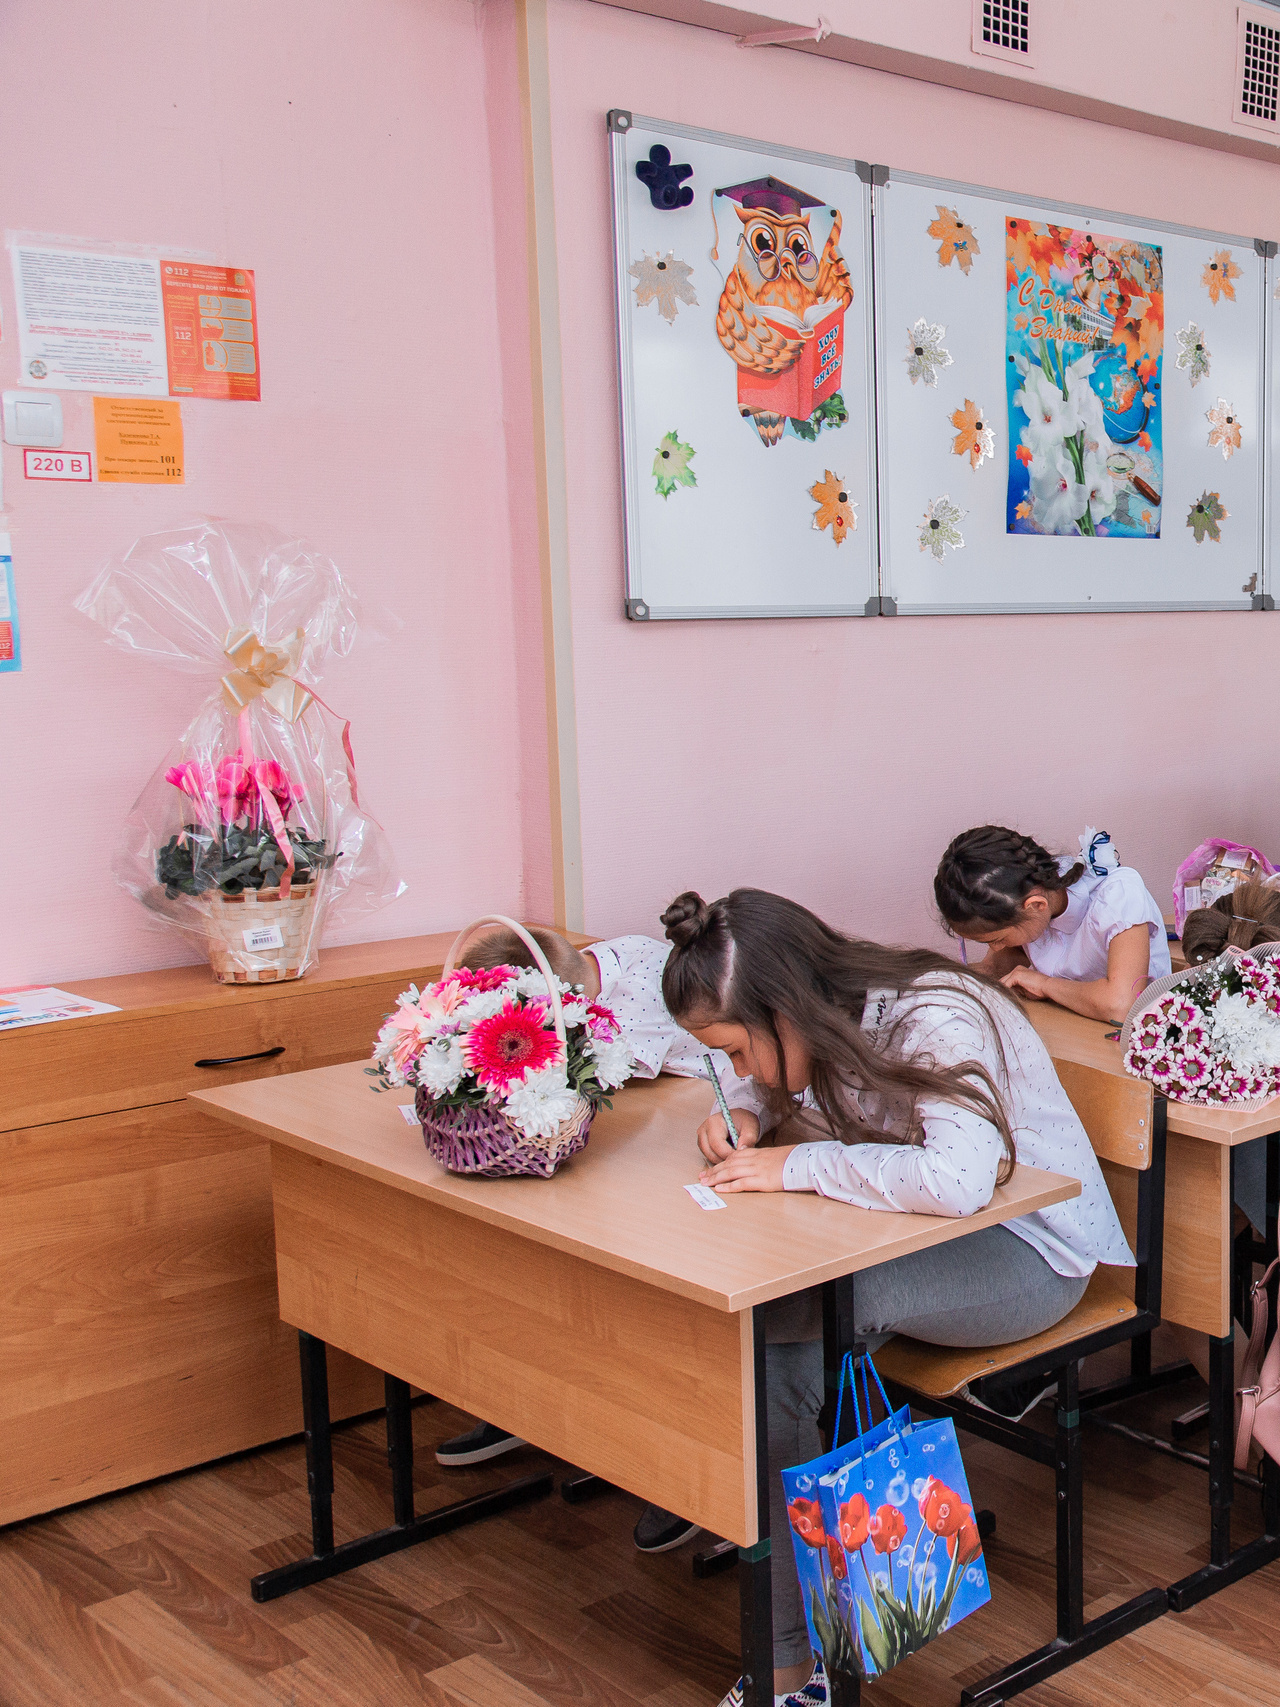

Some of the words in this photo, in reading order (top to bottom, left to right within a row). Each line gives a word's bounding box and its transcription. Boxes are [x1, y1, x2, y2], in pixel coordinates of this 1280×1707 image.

[174, 267, 189, 277] 112
[1018, 277, 1035, 307] С
[1039, 288, 1082, 316] Днем
[175, 331, 192, 340] 112
[818, 325, 839, 352] ХОЧУ
[1030, 316, 1100, 345] Знаний!
[813, 354, 842, 389] ЗНАТЬ!
[33, 457, 64, 472] 220
[70, 459, 83, 473] В
[160, 455, 176, 464] 101
[166, 468, 182, 477] 112
